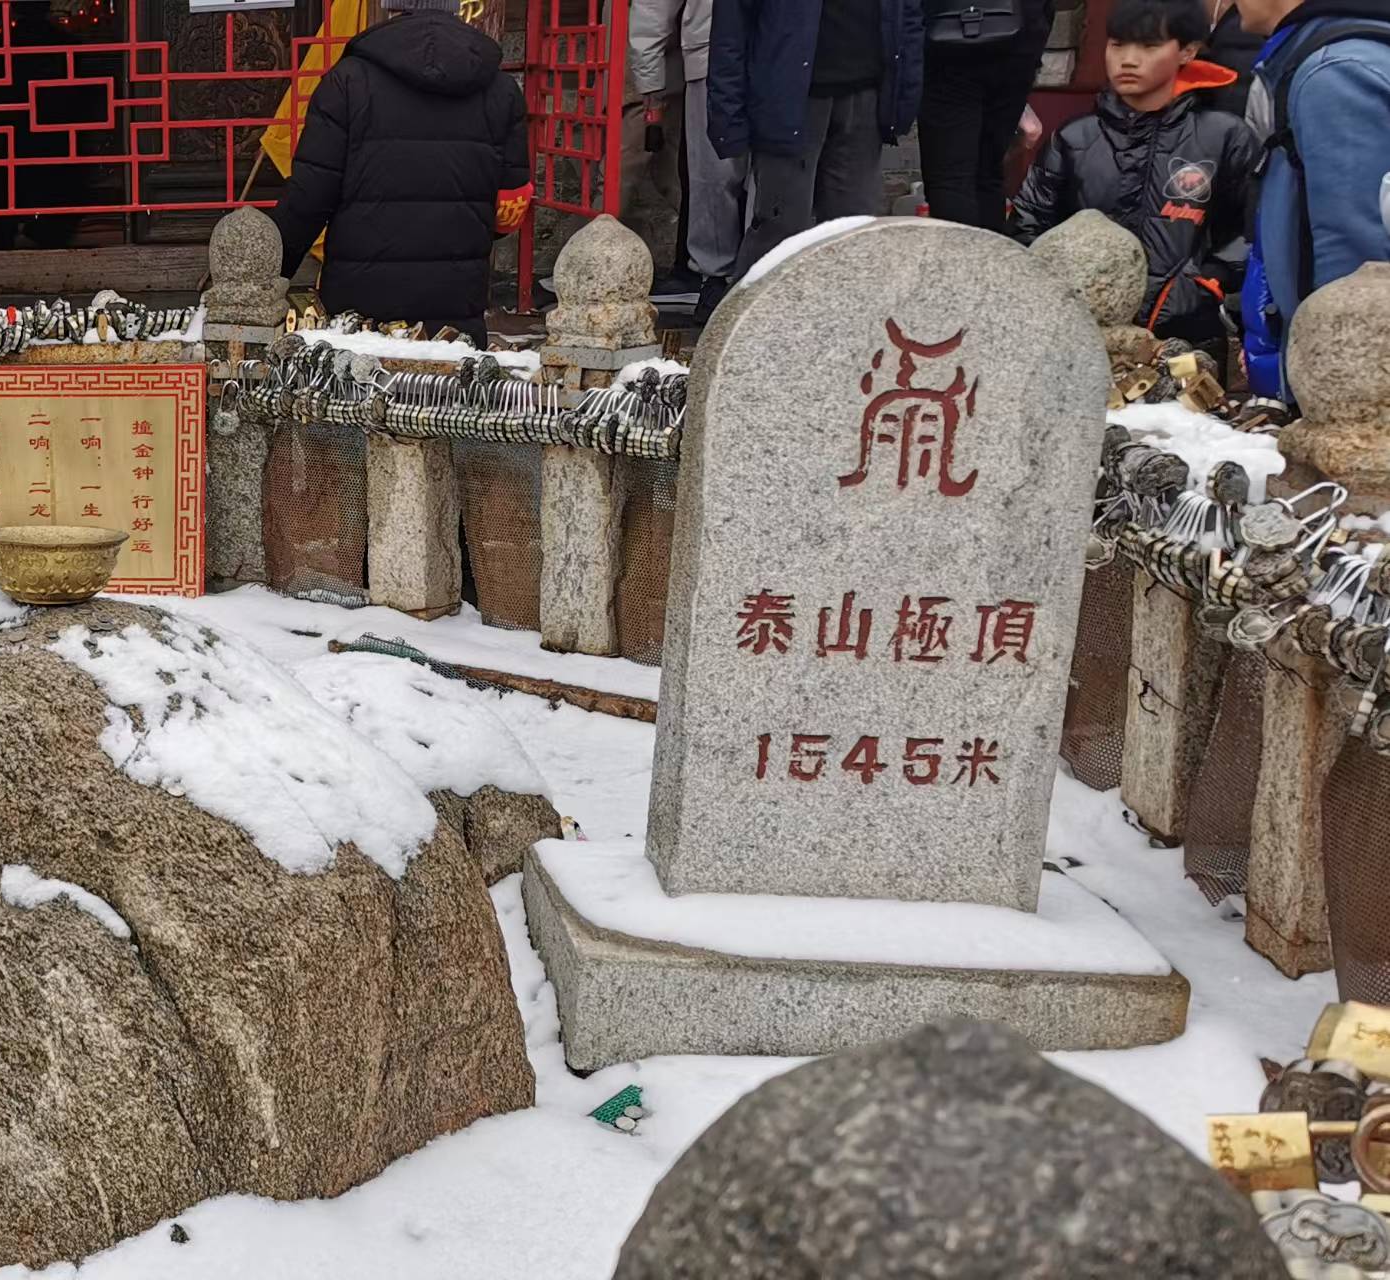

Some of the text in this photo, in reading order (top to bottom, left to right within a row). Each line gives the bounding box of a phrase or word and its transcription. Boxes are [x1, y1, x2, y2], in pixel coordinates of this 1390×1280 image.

[736, 588, 1041, 667] 泰山極頂
[754, 733, 1001, 788] 1545米
